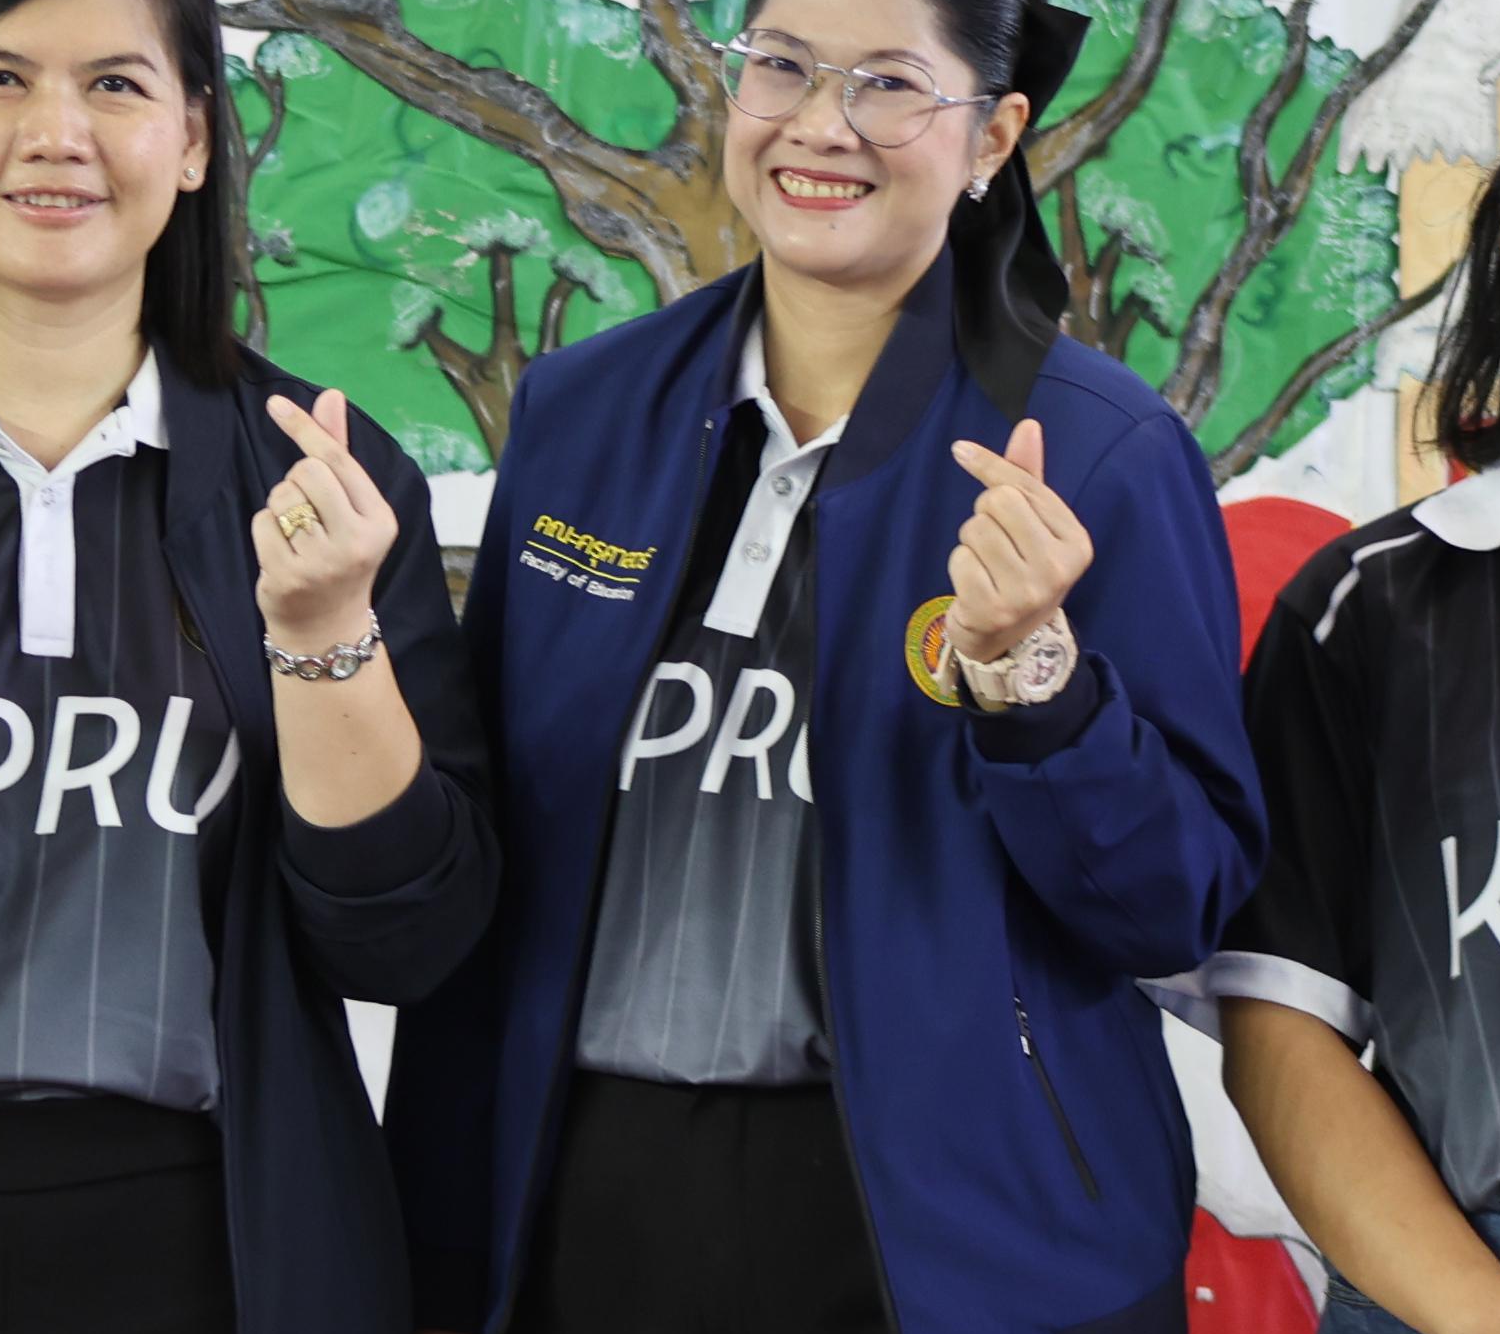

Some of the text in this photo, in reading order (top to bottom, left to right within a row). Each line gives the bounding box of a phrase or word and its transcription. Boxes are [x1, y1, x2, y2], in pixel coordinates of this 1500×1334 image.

[518, 549, 570, 582] Faculty
[566, 573, 589, 590] of
[617, 660, 815, 805] PR
